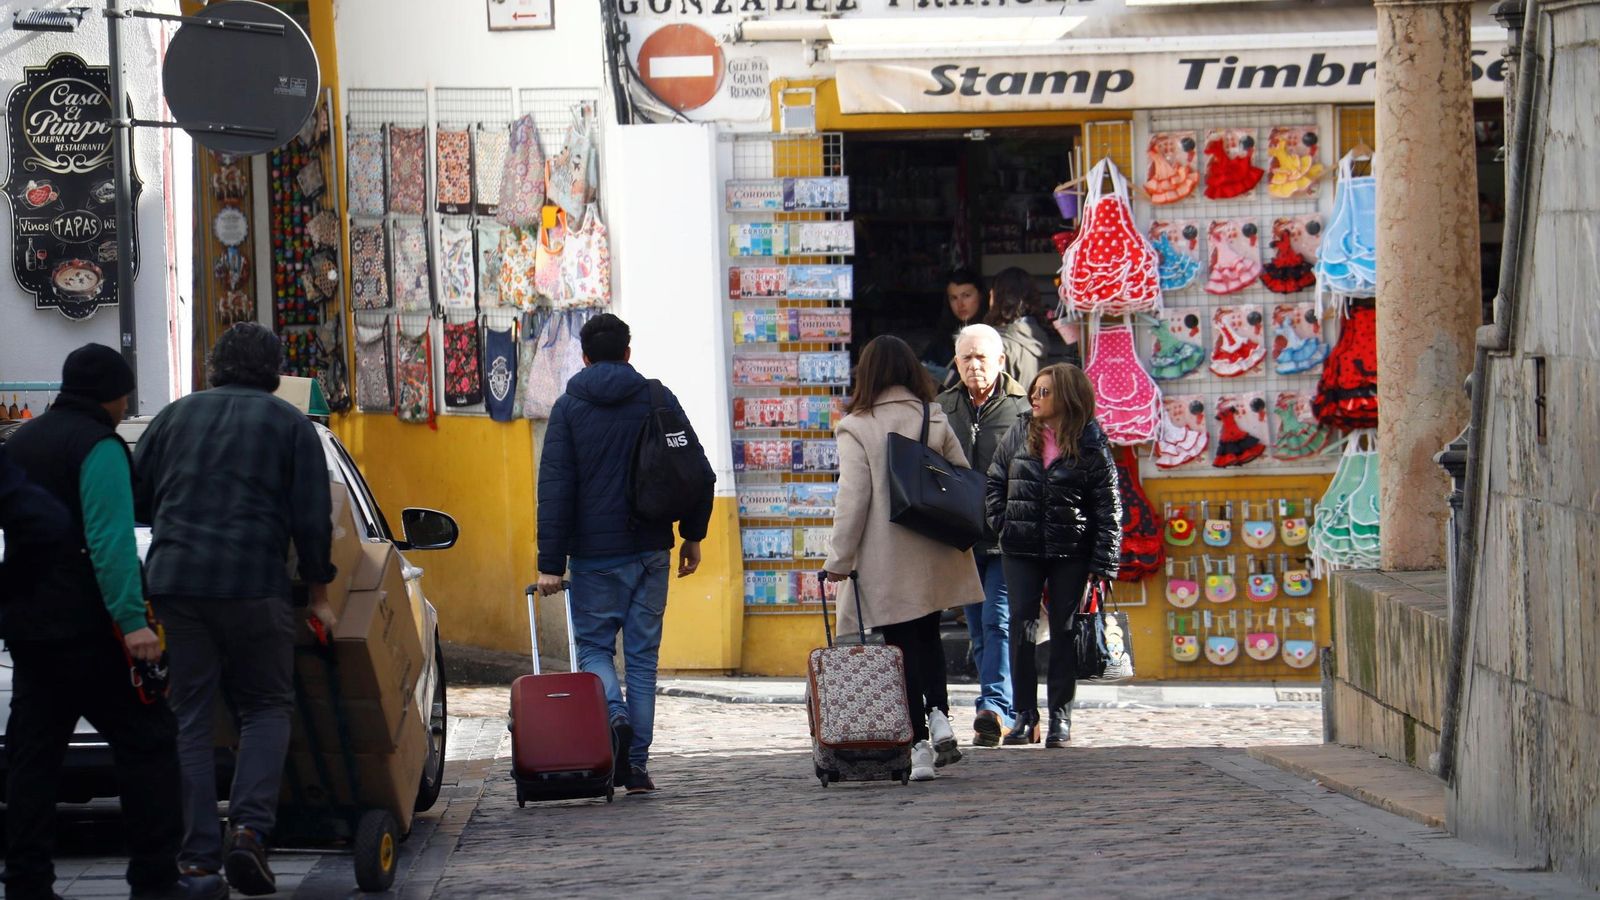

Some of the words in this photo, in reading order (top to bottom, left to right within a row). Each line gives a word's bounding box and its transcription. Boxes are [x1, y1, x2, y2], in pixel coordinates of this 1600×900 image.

[733, 72, 763, 84] GRADA
[923, 64, 1135, 104] Stamp
[1178, 52, 1376, 91] Timbr
[49, 83, 103, 106] Casa
[730, 84, 766, 98] REDONDA
[63, 105, 82, 120] El
[31, 135, 65, 144] TABERNA
[54, 142, 105, 152] RESTAURANTE
[21, 219, 50, 232] Vinos
[54, 215, 98, 238] TAPAS
[103, 219, 116, 230] Wi
[740, 494, 787, 505] CORDOBA
